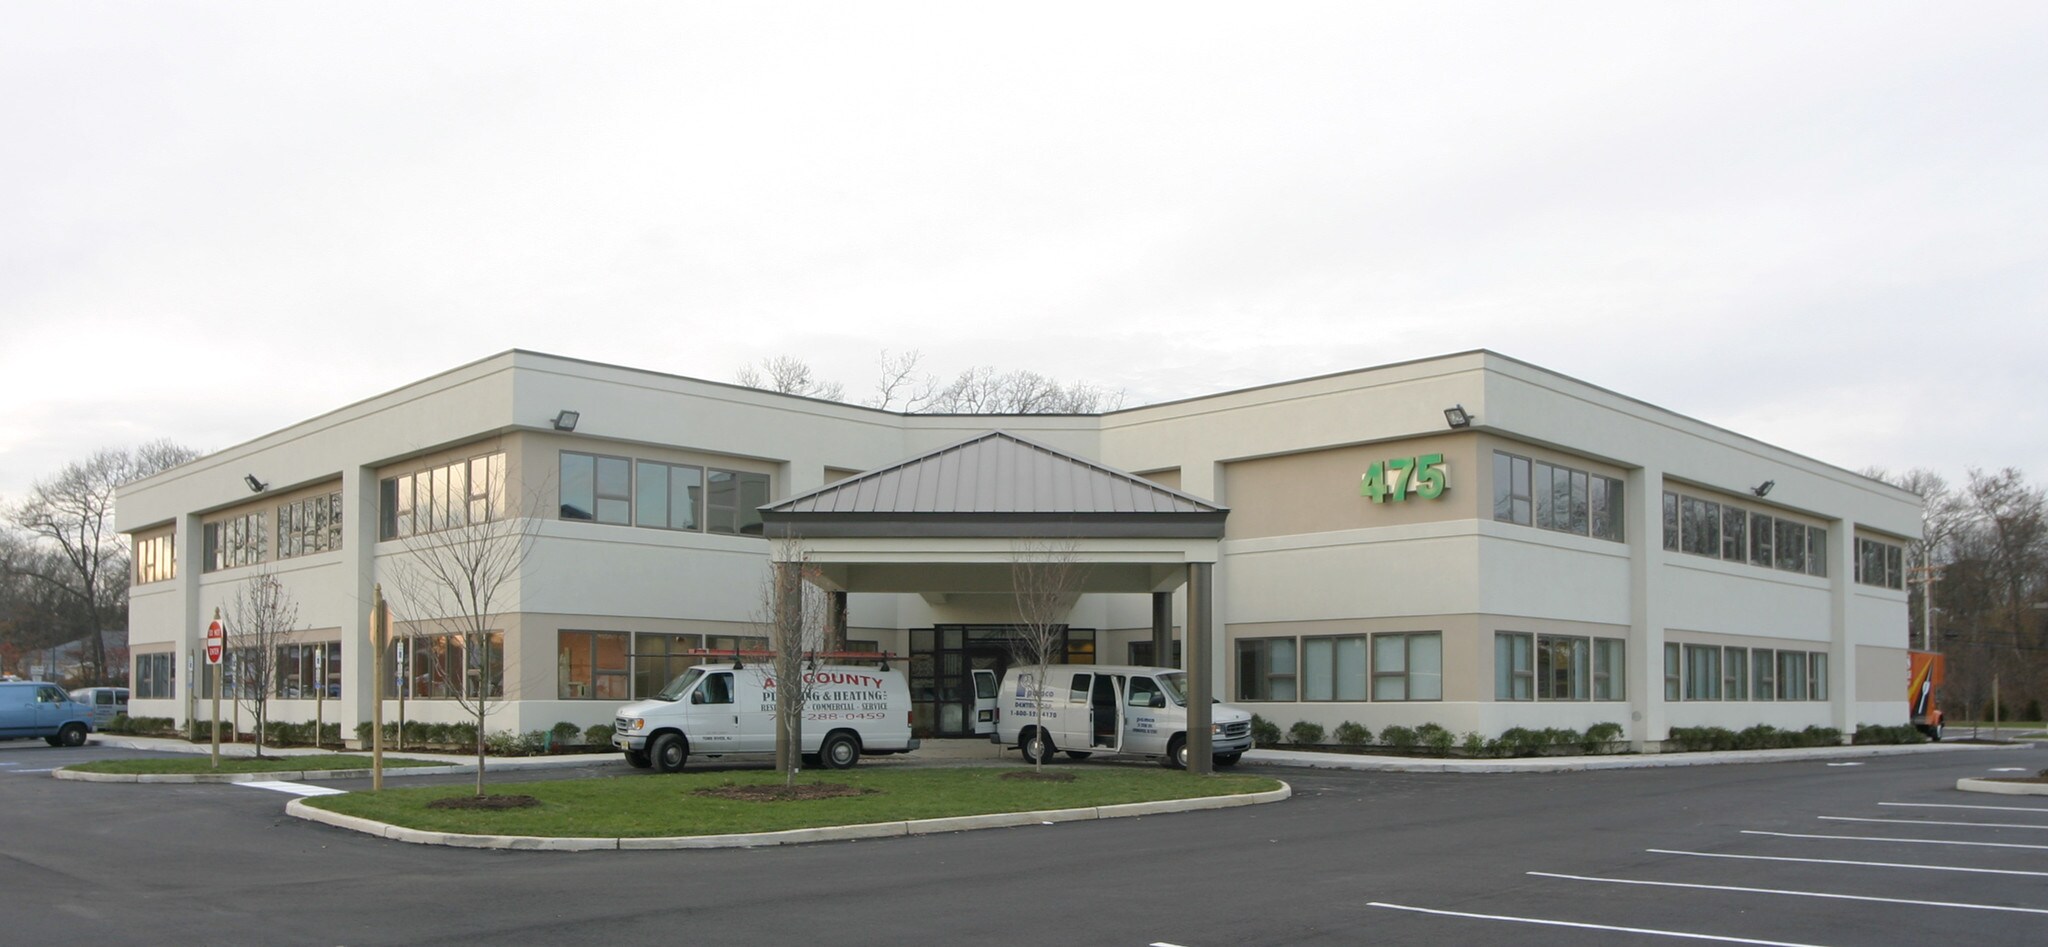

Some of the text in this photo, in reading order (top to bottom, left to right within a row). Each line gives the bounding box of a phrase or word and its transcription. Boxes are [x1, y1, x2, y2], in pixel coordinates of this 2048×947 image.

[1360, 453, 1446, 503] 475
[803, 672, 883, 688] COUNTY
[823, 691, 832, 701] &
[834, 690, 882, 701] HEATING
[812, 703, 854, 711] COMMERCIAL
[862, 702, 888, 711] SERVICE
[768, 712, 886, 721] 7-288-0459
